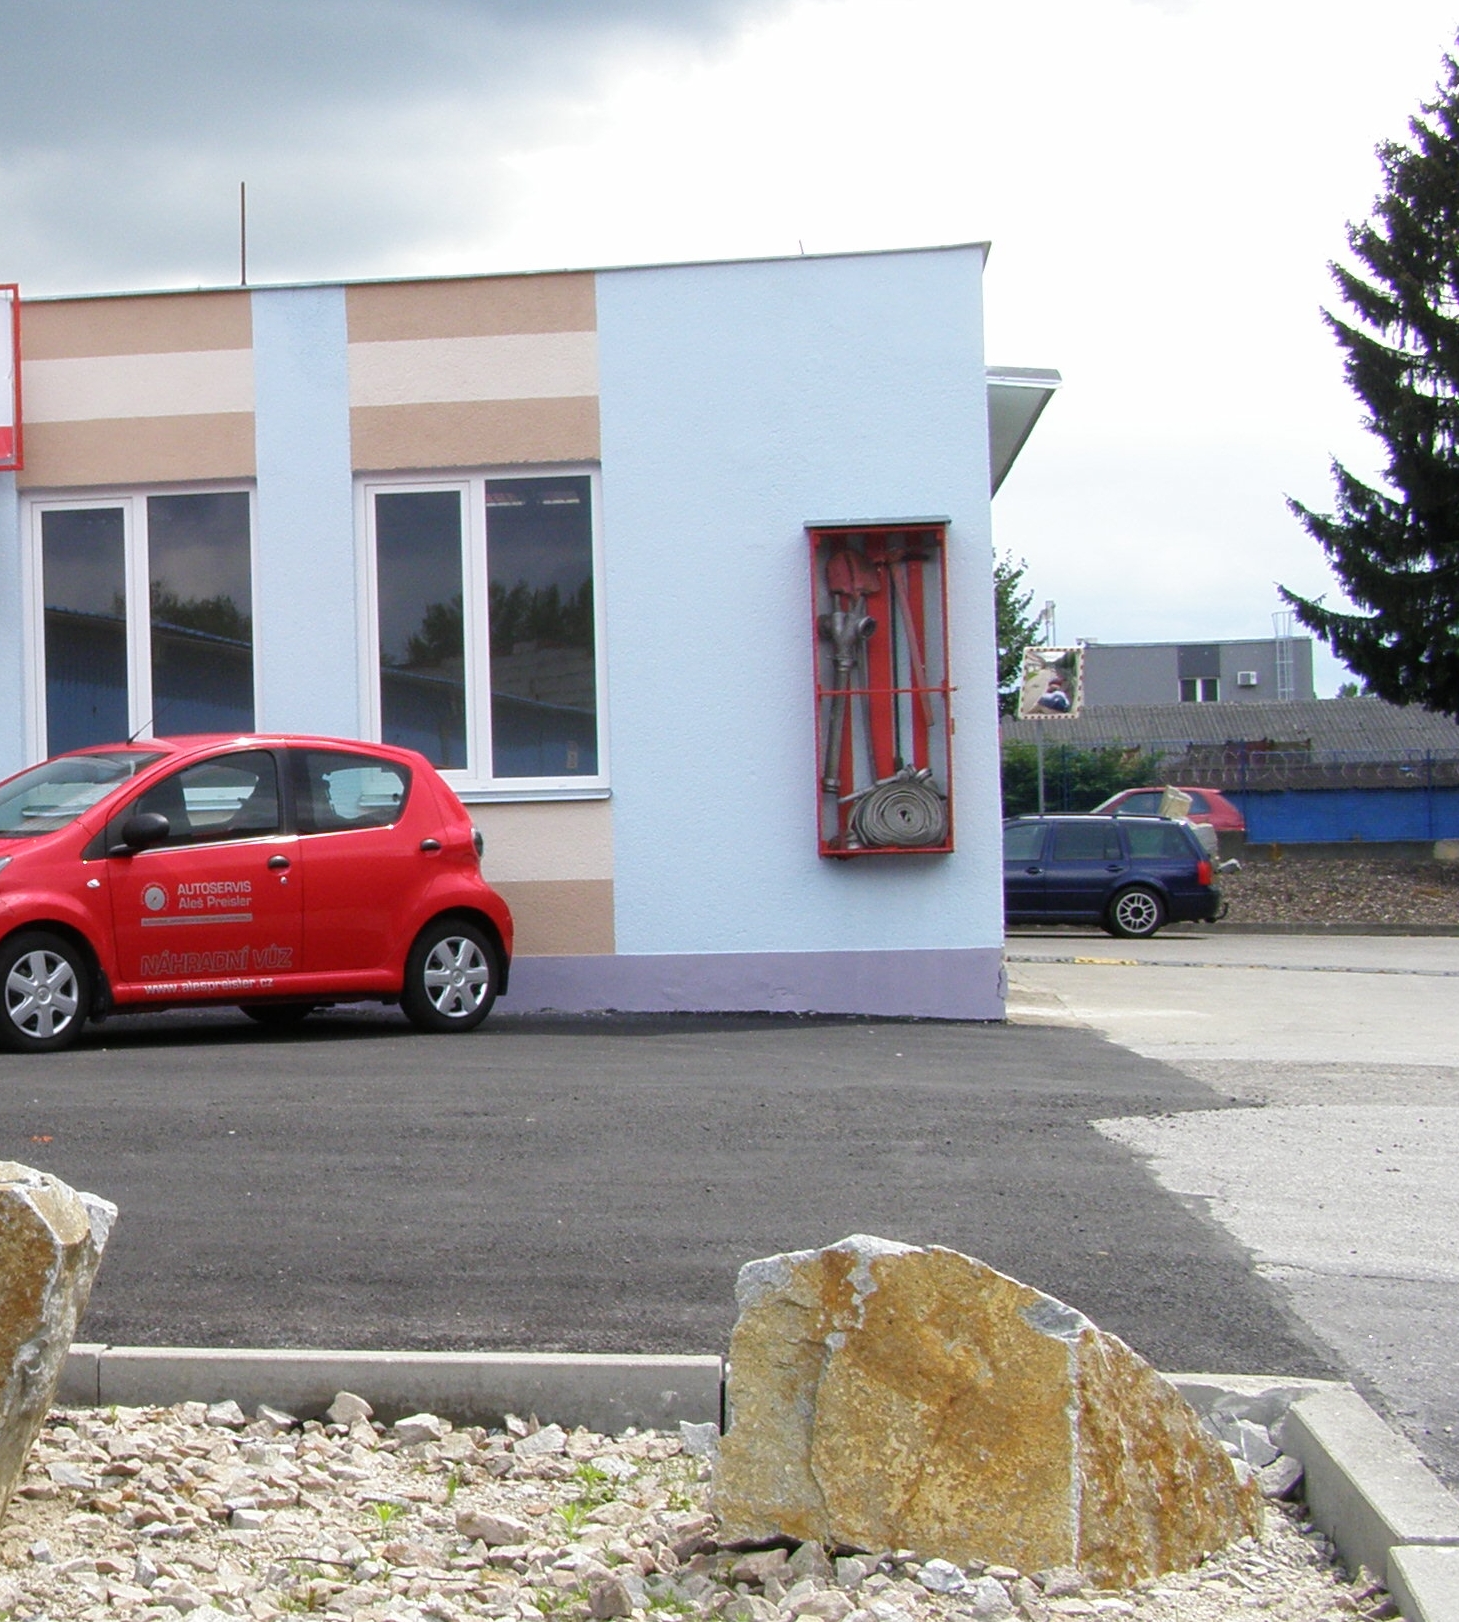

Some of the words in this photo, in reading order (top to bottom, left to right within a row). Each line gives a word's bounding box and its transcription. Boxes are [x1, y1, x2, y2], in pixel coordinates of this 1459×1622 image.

[177, 880, 252, 895] AUTOSERVIS
[179, 897, 204, 909] Aleš
[207, 894, 252, 908] Preisler
[141, 946, 249, 976] NÁHRADNÍ
